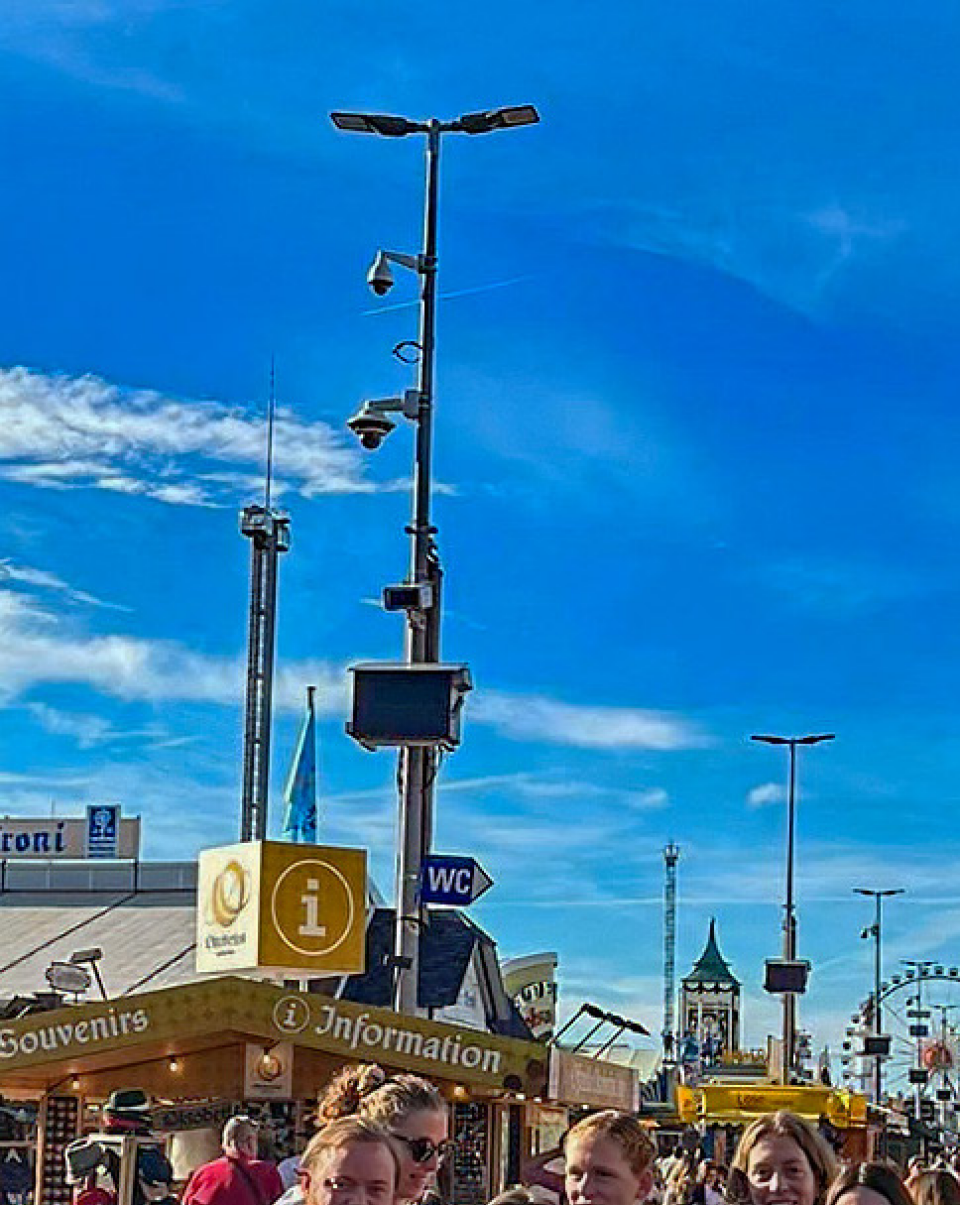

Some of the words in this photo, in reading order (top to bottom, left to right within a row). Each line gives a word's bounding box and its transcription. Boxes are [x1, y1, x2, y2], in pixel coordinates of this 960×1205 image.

[0, 822, 66, 852] roni
[428, 866, 471, 893] WC
[298, 878, 326, 937] i
[0, 1008, 148, 1058] Souvenirs
[315, 1005, 500, 1073] Information
